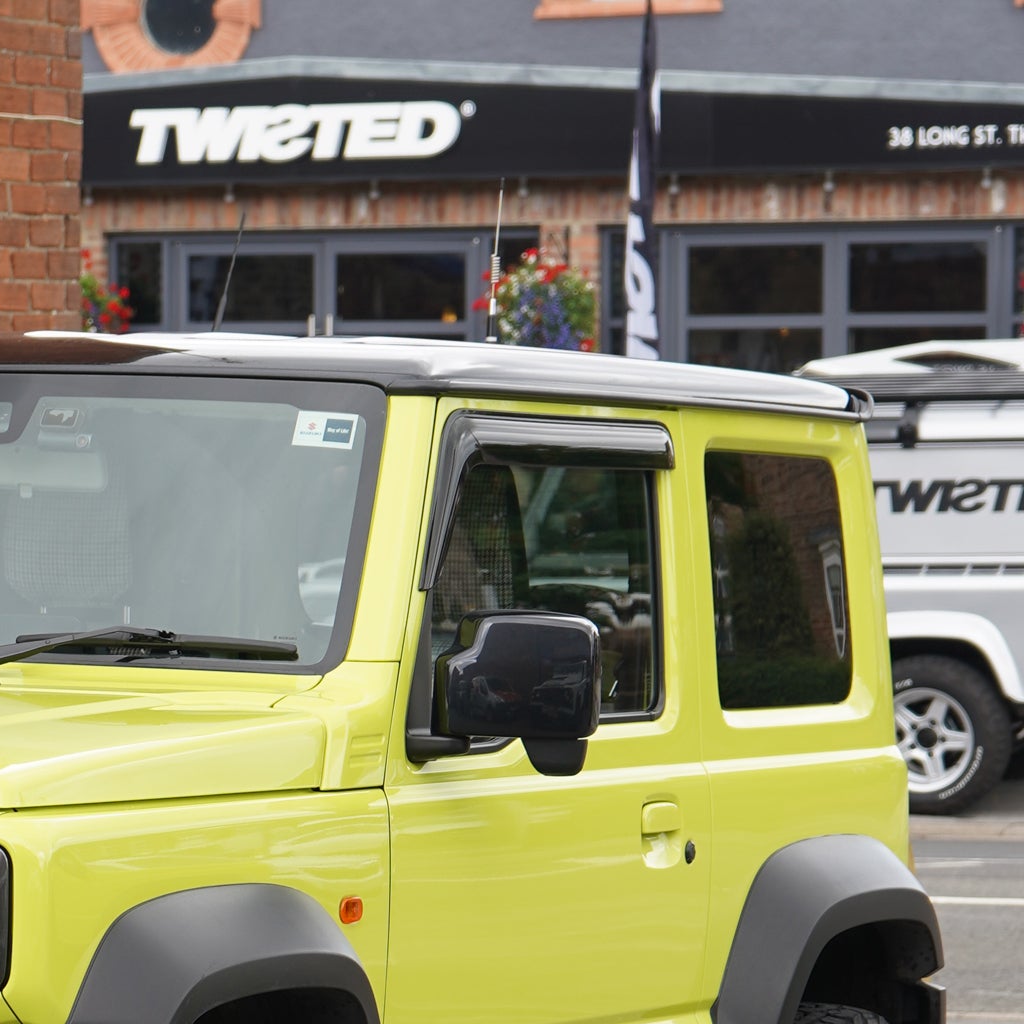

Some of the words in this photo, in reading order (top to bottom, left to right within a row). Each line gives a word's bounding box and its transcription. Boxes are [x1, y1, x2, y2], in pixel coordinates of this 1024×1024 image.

[888, 126, 914, 147] 38
[918, 126, 970, 147] LONG
[974, 124, 1003, 145] ST.
[872, 479, 1024, 513] WIST
